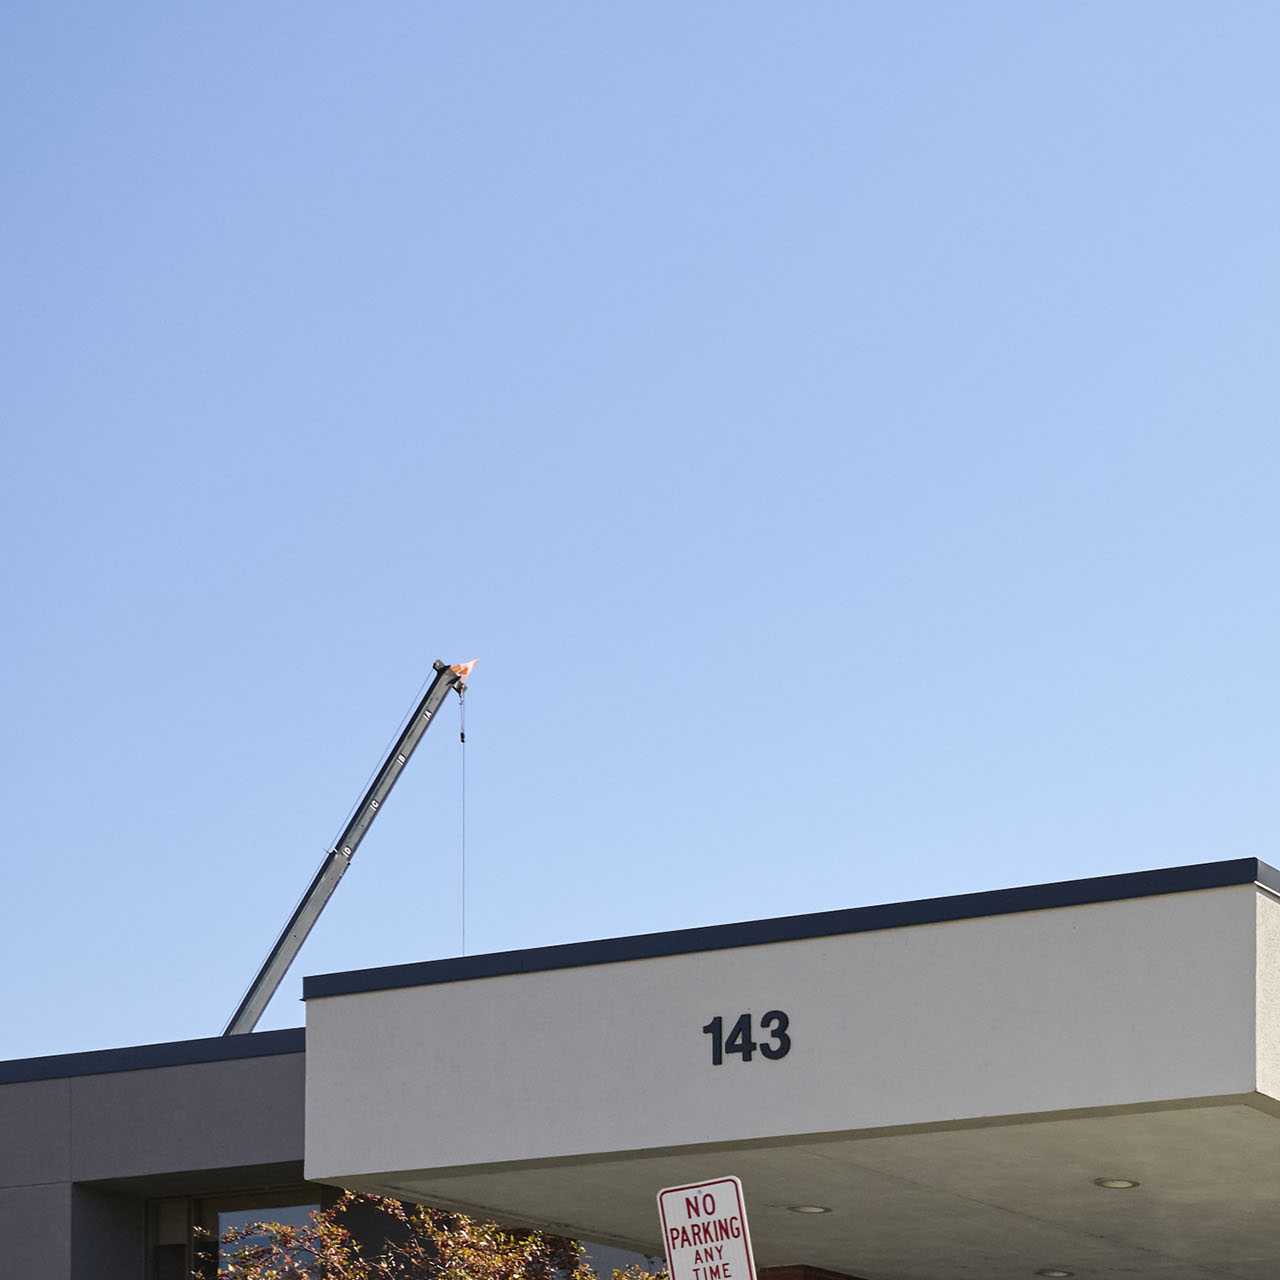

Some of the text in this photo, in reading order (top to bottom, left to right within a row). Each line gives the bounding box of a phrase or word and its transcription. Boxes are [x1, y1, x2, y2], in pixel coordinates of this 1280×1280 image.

[703, 1010, 791, 1065] 143
[685, 1193, 716, 1219] NO
[669, 1216, 741, 1250] PARKING
[694, 1245, 724, 1265] ANY
